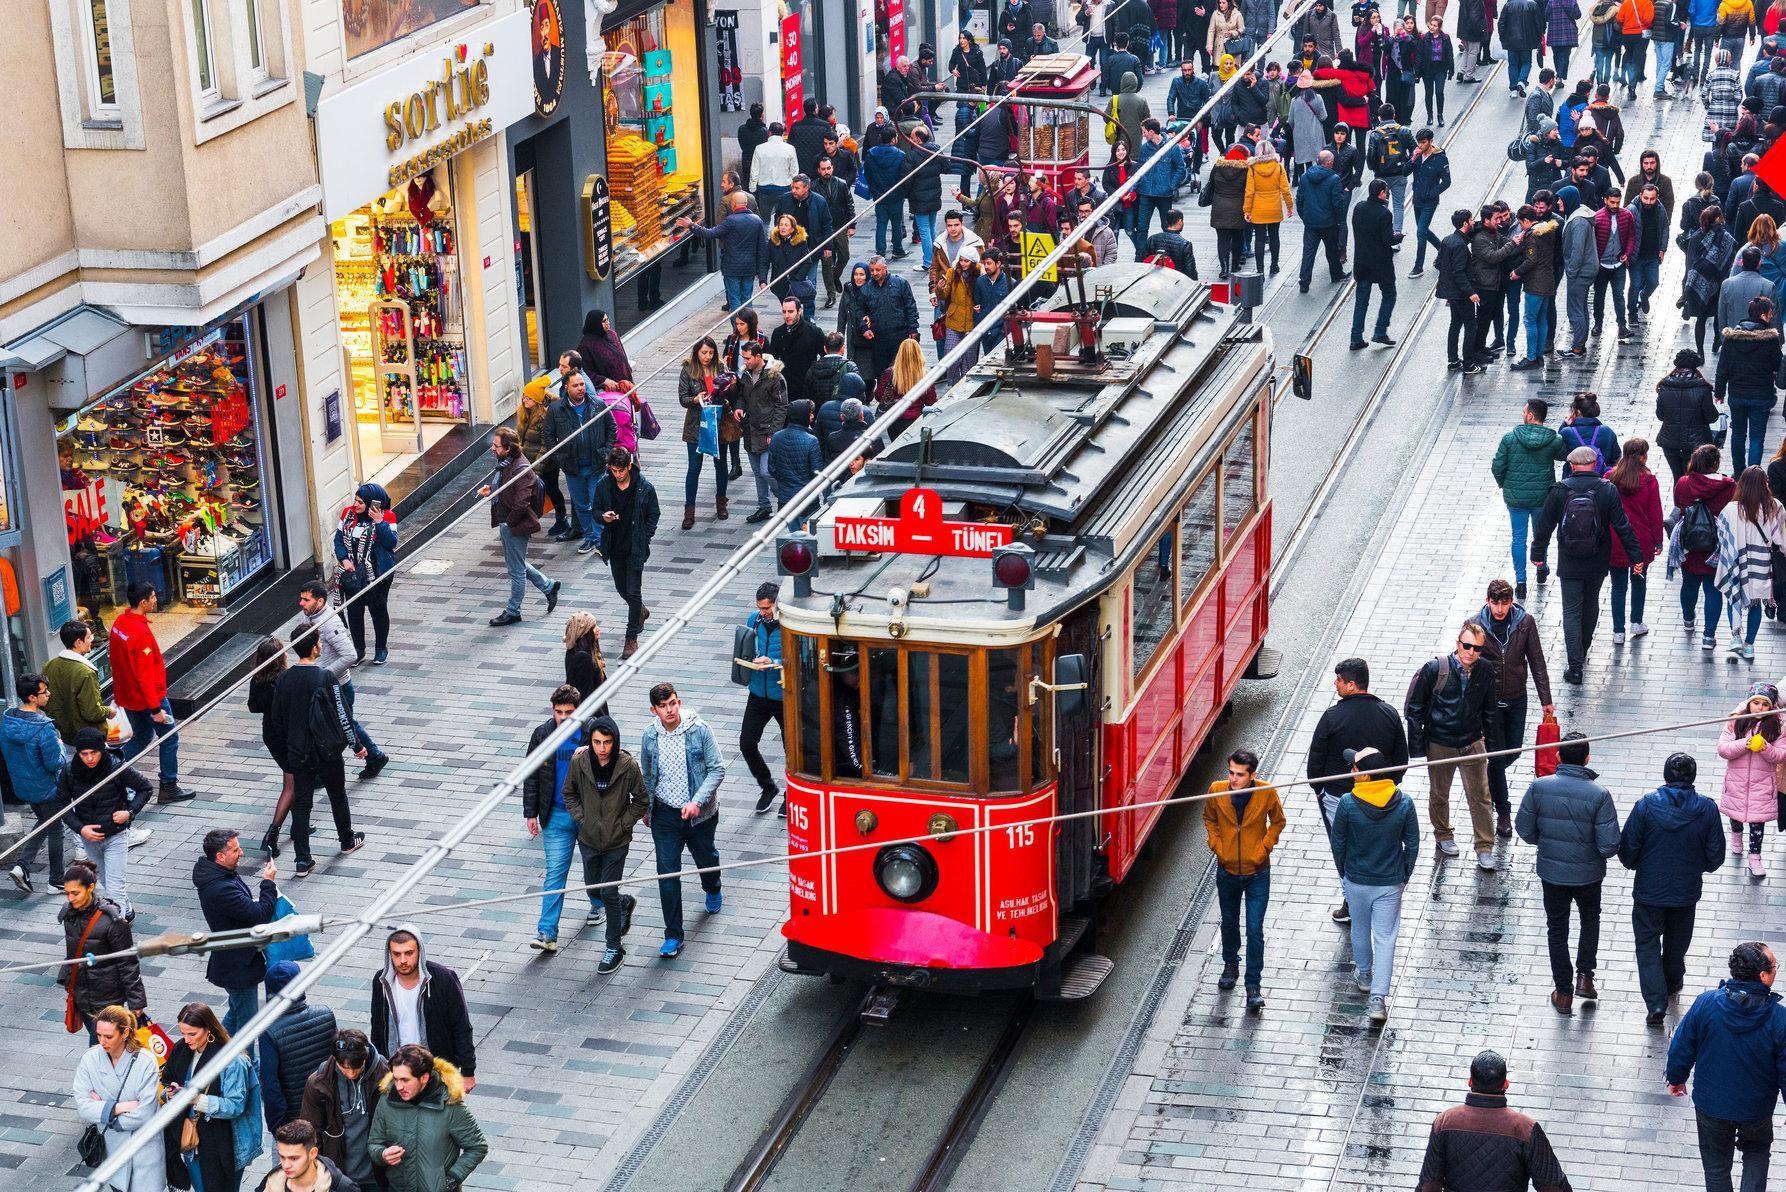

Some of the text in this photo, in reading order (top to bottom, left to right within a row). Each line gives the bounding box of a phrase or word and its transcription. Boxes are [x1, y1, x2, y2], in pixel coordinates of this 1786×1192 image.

[384, 44, 490, 151] sortie
[174, 347, 192, 361] VANS
[65, 477, 109, 545] SALE
[912, 494, 926, 519] 4
[836, 521, 895, 547] TAKSİM
[789, 801, 809, 831] 115
[1006, 823, 1035, 849] 115
[1031, 889, 1047, 903] YASAK
[996, 910, 1007, 920] VE
